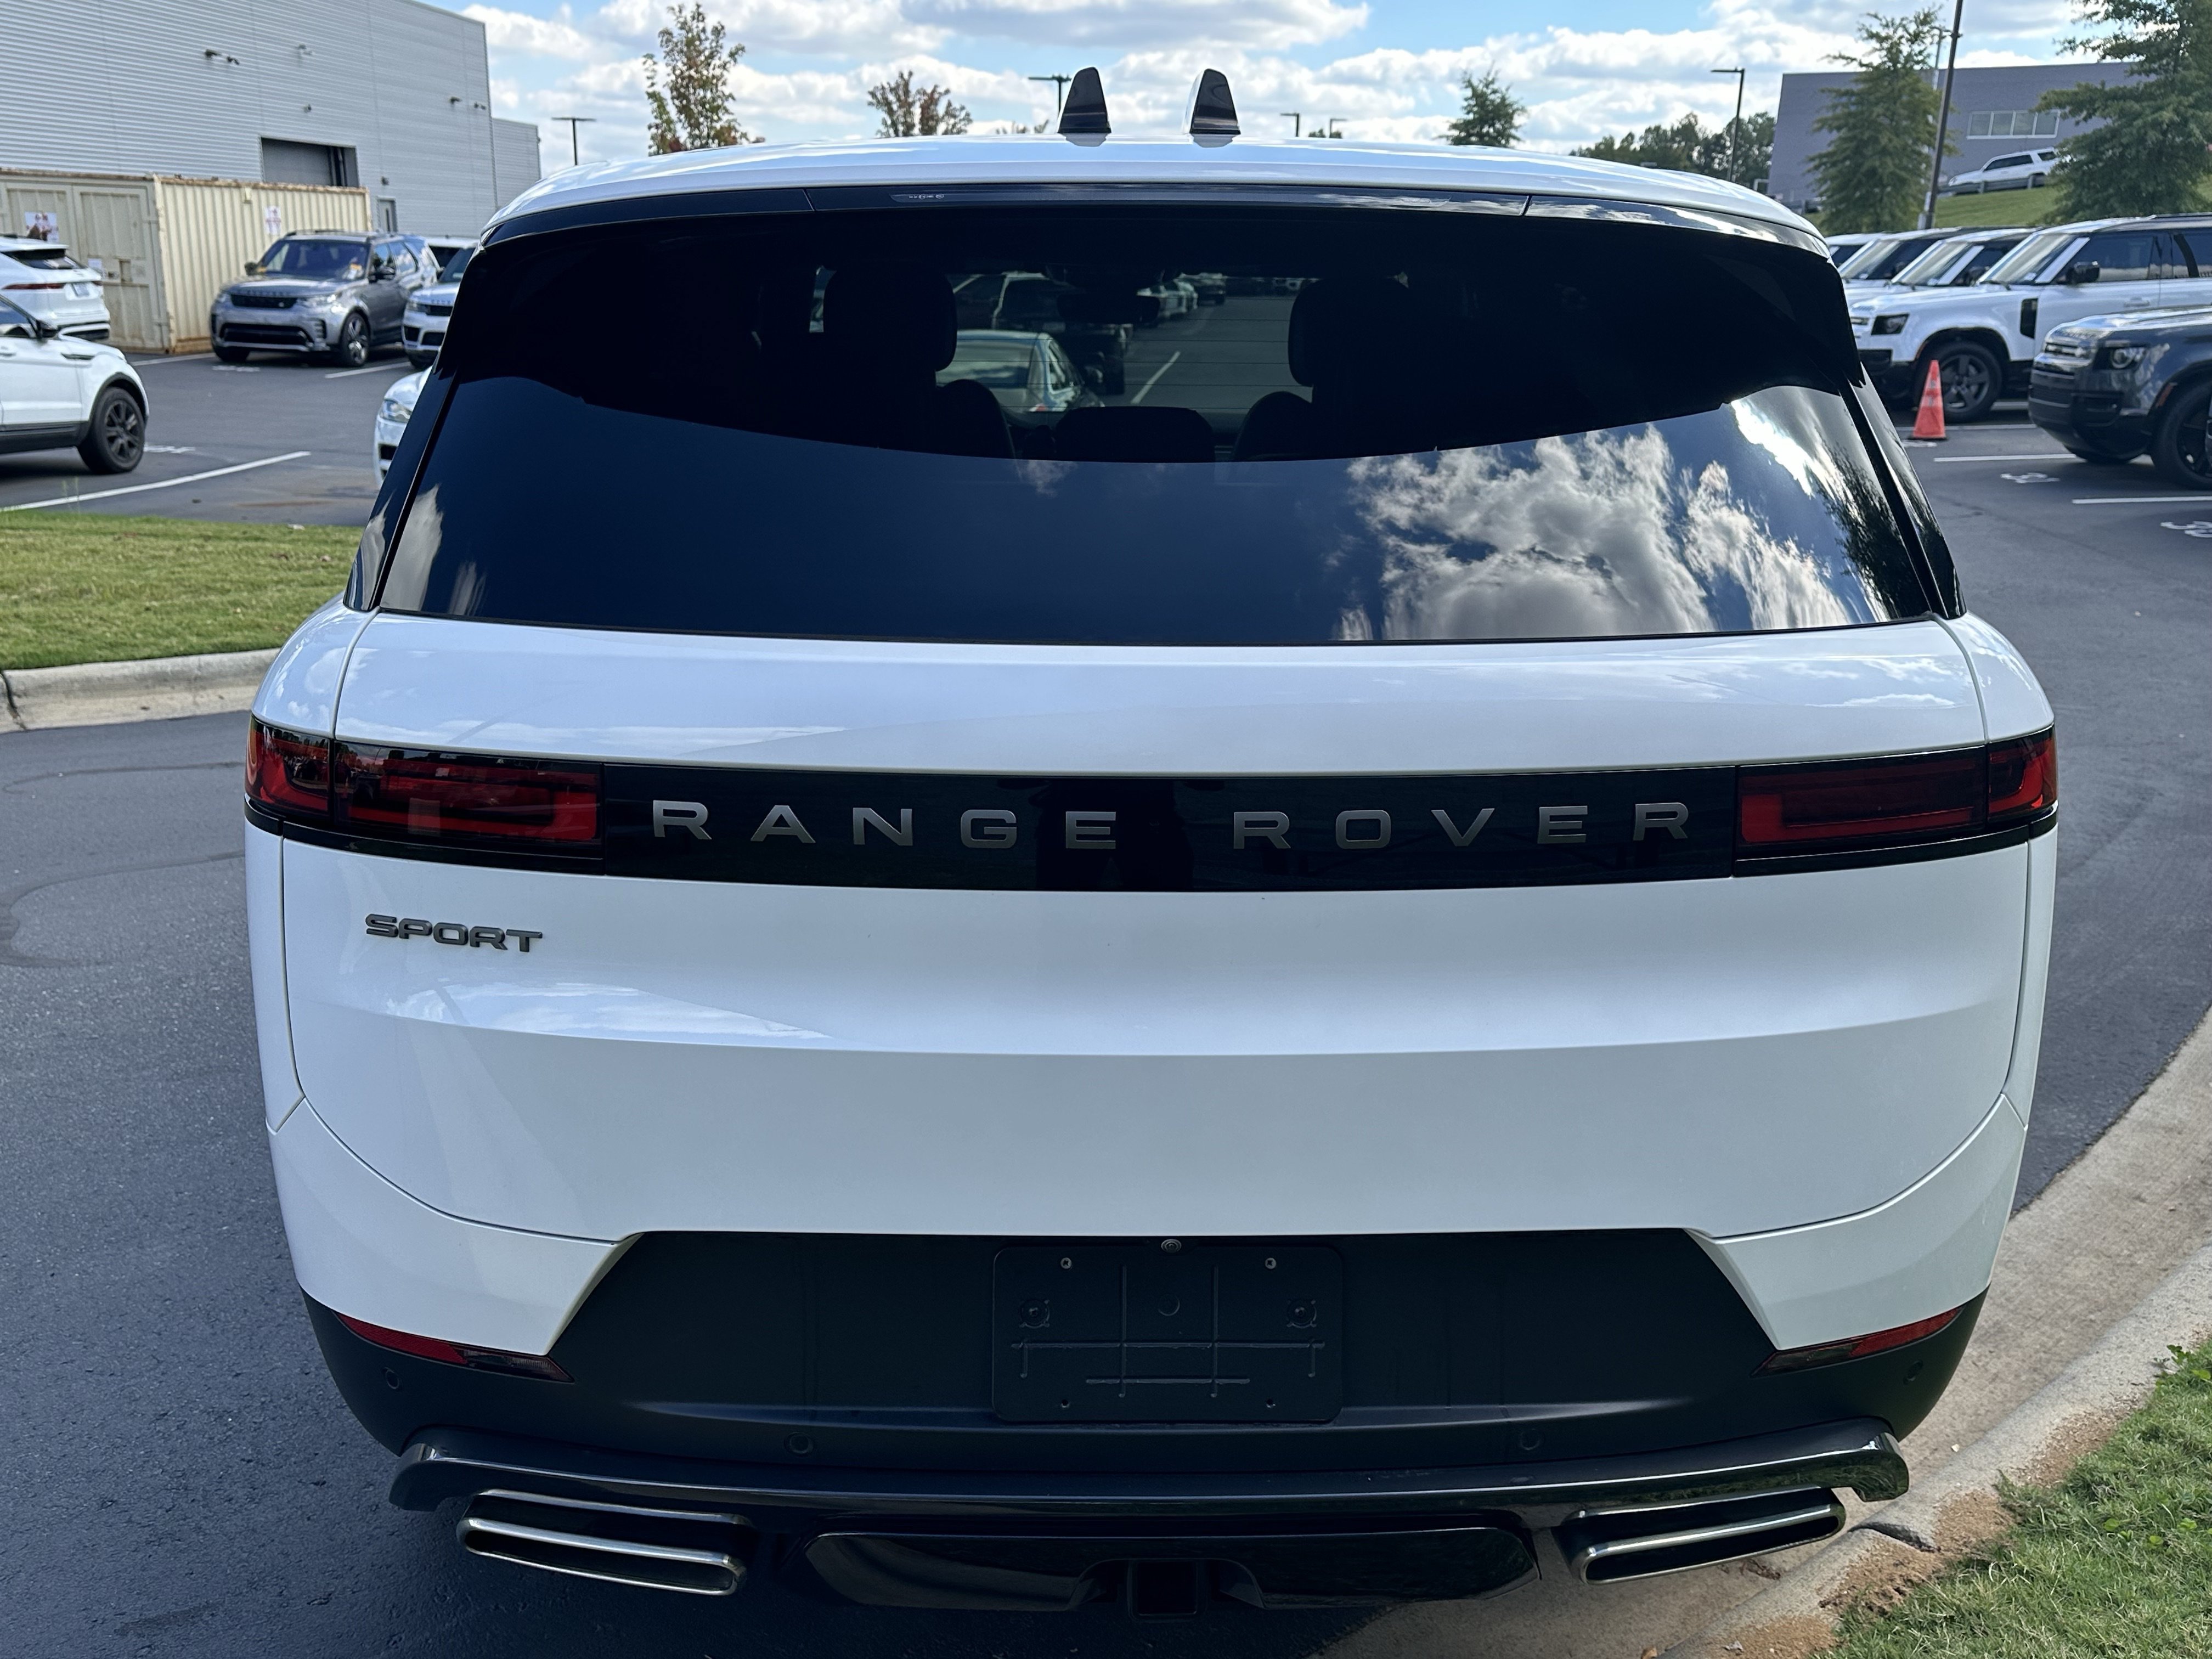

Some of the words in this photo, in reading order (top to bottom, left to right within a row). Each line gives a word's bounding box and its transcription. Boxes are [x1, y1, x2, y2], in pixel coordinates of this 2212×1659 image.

[652, 799, 1116, 849] RANGE
[1233, 802, 1690, 849] ROVER
[365, 913, 543, 952] SPORT
